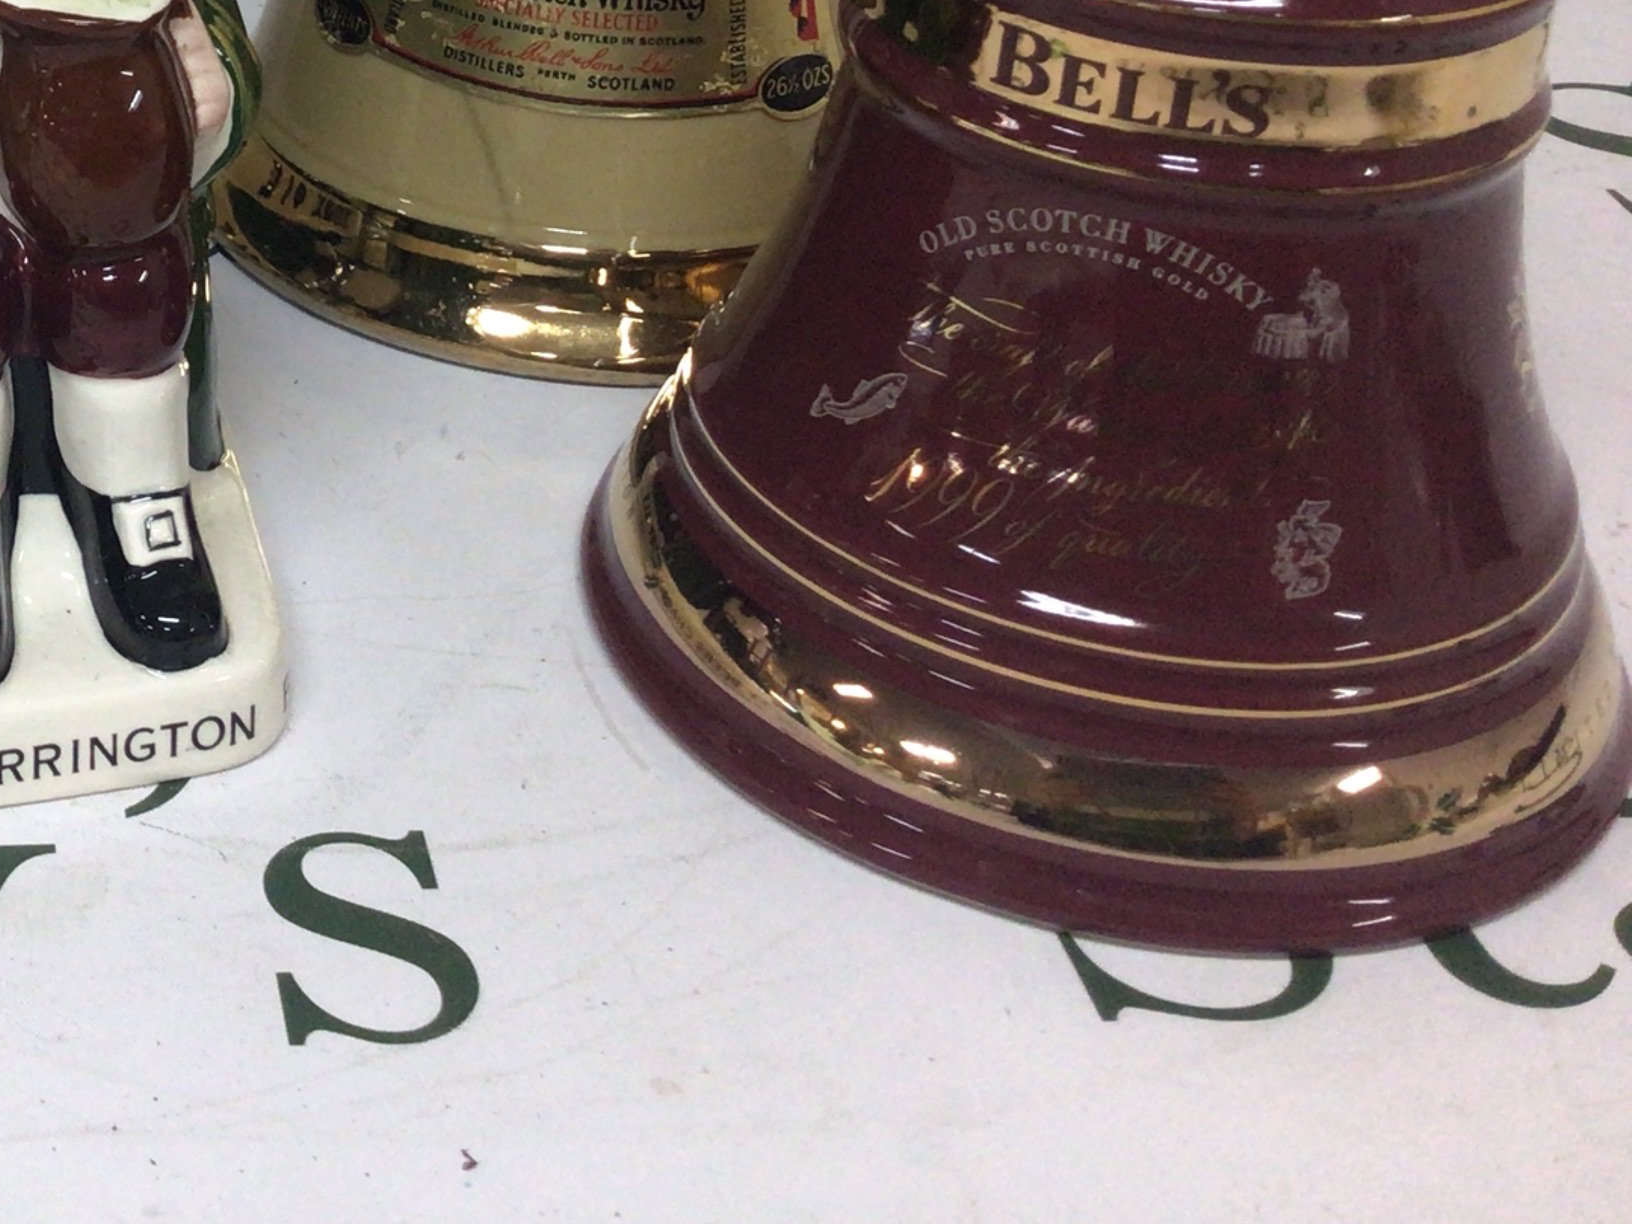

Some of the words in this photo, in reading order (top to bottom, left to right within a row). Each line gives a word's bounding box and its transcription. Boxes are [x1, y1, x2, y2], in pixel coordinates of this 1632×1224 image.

[432, 0, 486, 23] DISTILLED
[564, 31, 618, 46] BOTTLED
[622, 37, 634, 46] IN
[572, 10, 659, 32] SELECTED
[444, 45, 525, 79] DISTILLERS
[587, 75, 676, 92] SCOTLAND
[989, 19, 1271, 139] BELL'S
[919, 214, 976, 254] OLD
[984, 207, 1131, 245] SCOTCH
[1143, 227, 1275, 312] WHISKY
[964, 241, 1016, 261] PURE
[1026, 240, 1142, 271] SCOTTISH
[1151, 266, 1210, 301] GOLD
